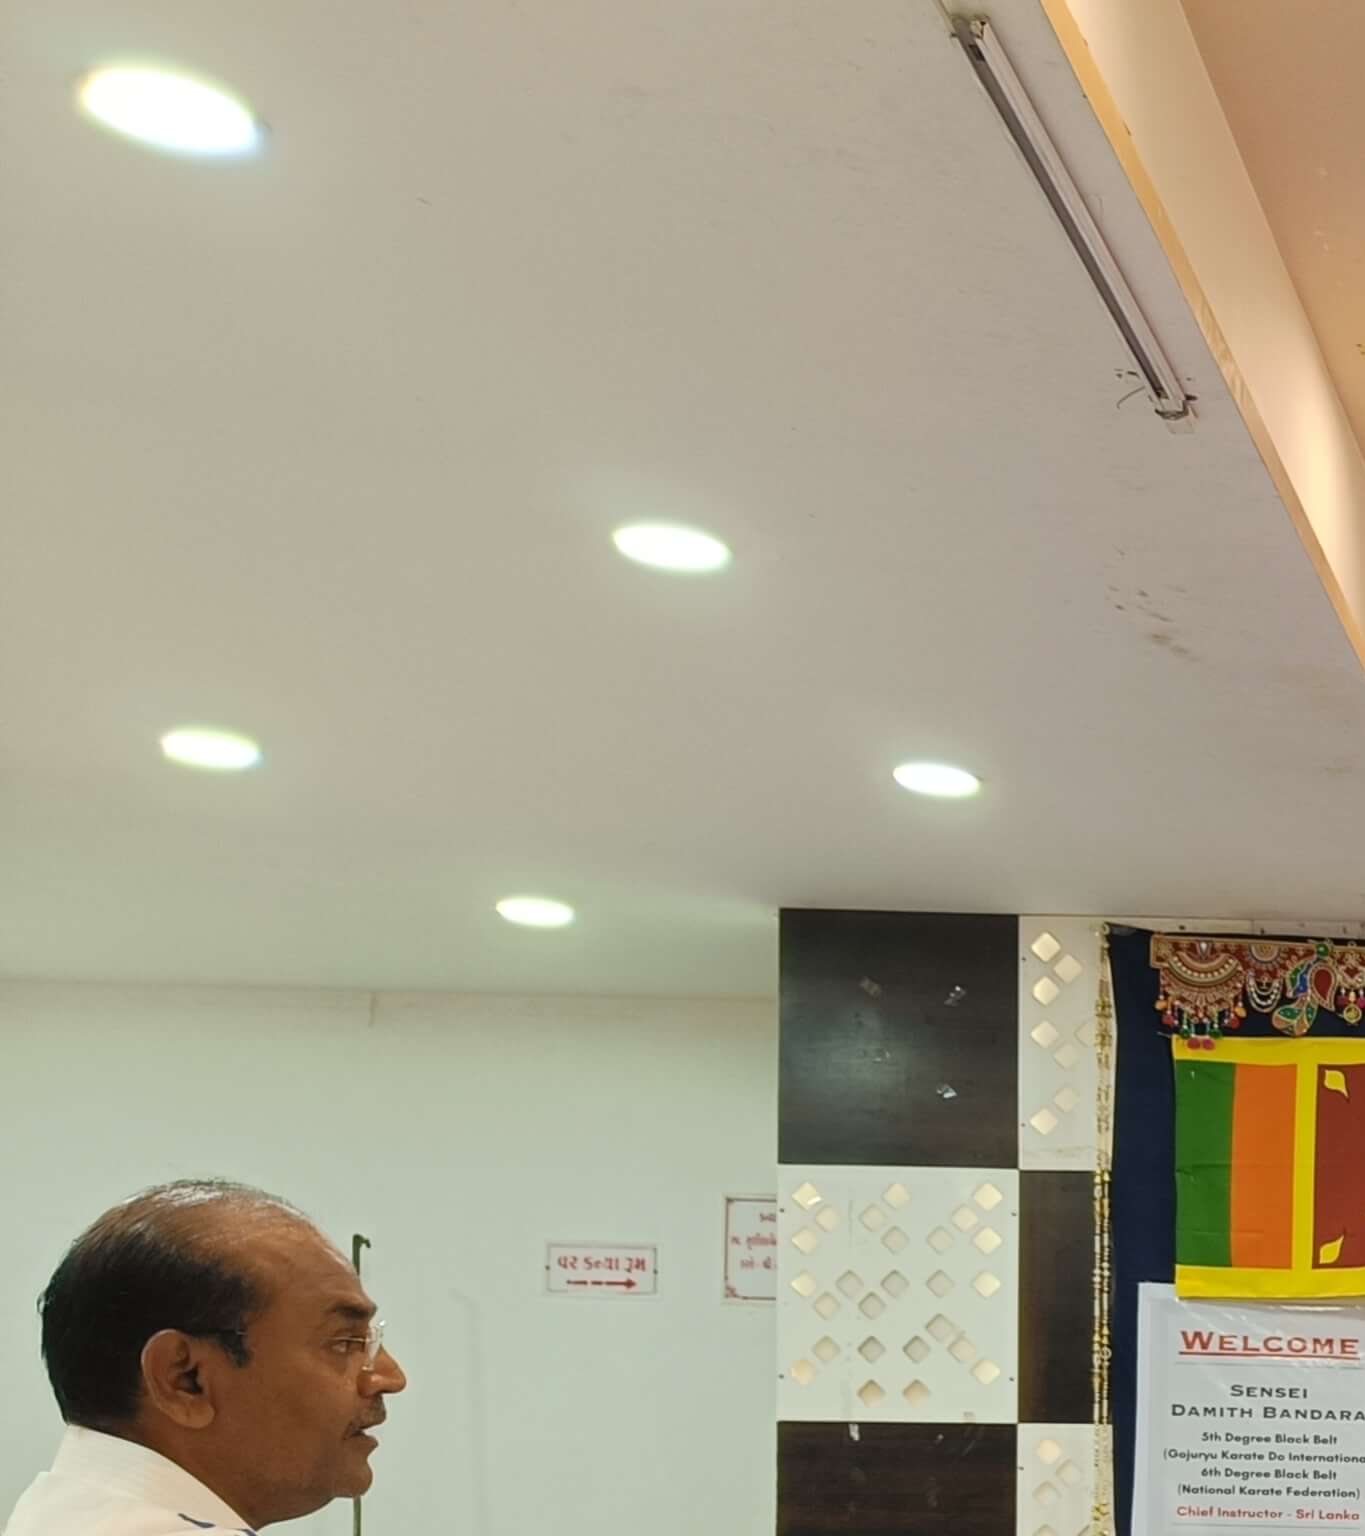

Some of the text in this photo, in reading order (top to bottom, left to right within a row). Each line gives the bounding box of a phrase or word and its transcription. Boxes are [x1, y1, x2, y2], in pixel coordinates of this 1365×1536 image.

[1181, 1331, 1359, 1355] WELCOME
[1230, 1384, 1308, 1399] SENSEI
[1171, 1404, 1253, 1418] DAMITH
[1201, 1432, 1338, 1446] 5th Degree Black Belt
[1163, 1448, 1218, 1462] (Gojuryu
[1221, 1450, 1265, 1461] Karate
[1269, 1451, 1285, 1461] Do
[1201, 1468, 1337, 1481] 6th Degree Black Belt
[1178, 1484, 1360, 1499] (National Karate Federation)
[1177, 1507, 1214, 1517] Chief
[1218, 1508, 1283, 1519] Instructor
[1296, 1509, 1316, 1520] Sri
[1319, 1510, 1360, 1521] Lanka
